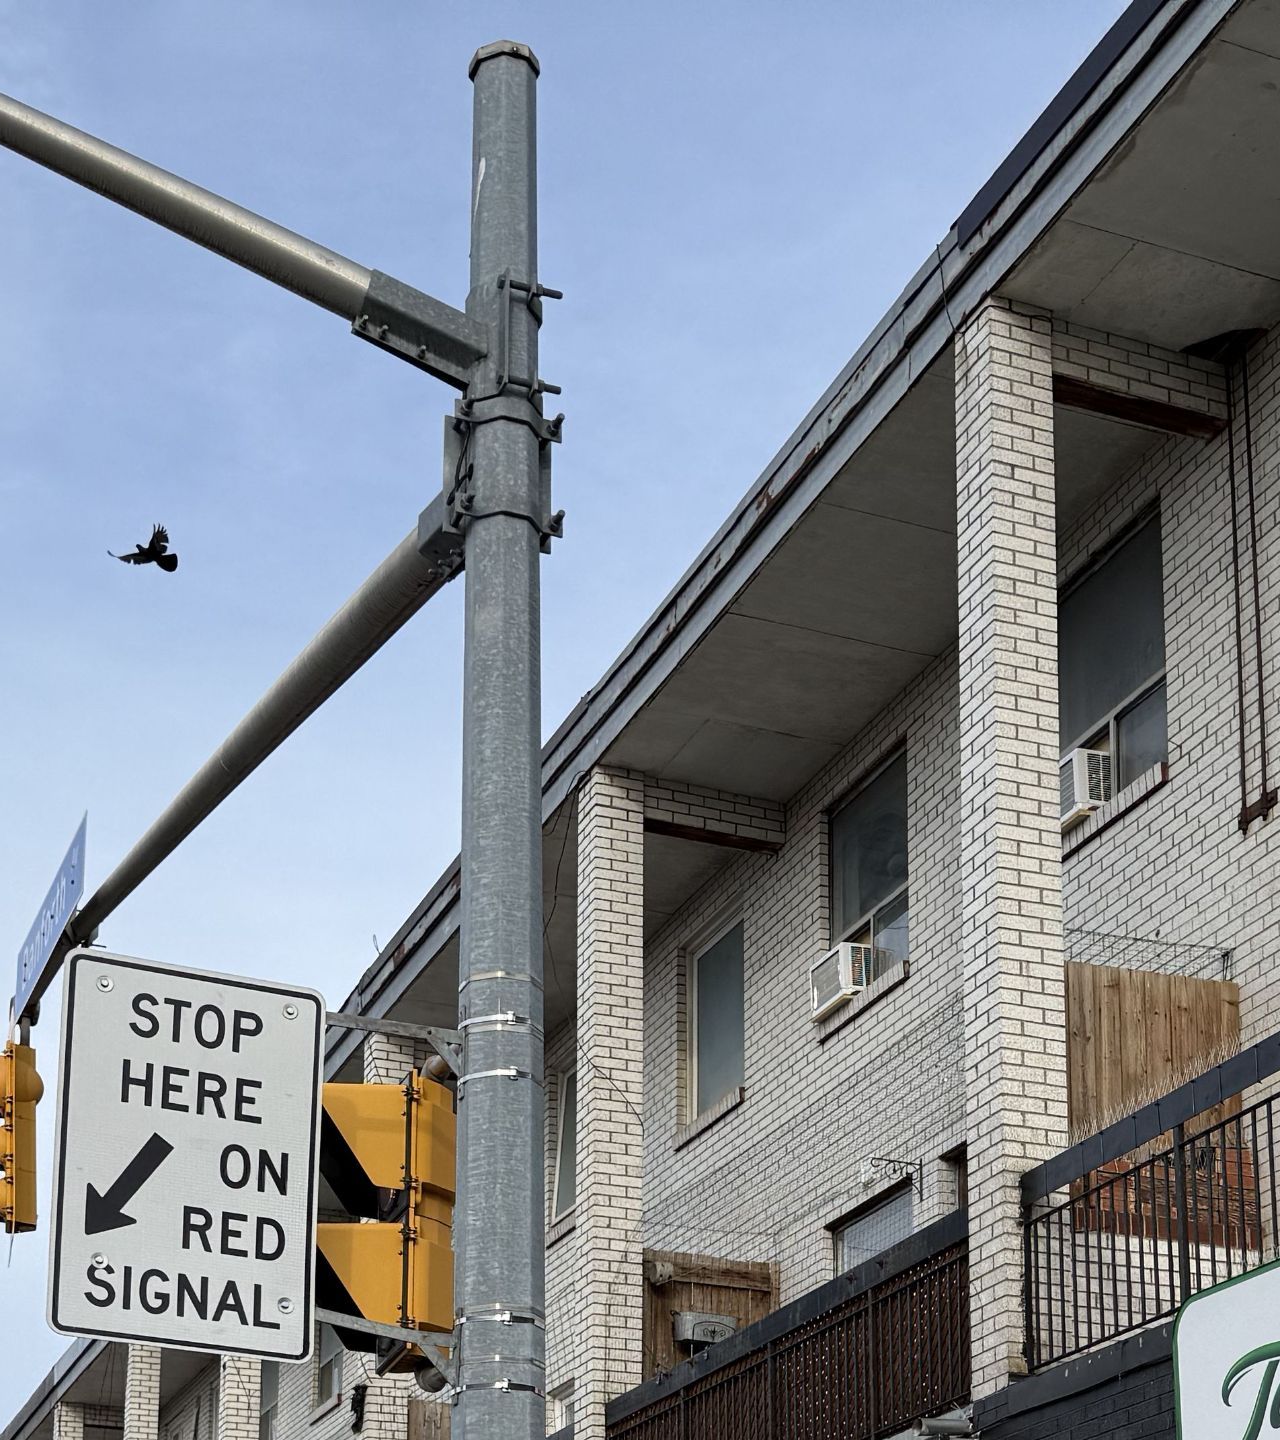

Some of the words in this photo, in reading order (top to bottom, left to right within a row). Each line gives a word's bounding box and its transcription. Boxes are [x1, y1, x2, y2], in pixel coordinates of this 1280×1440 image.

[129, 992, 263, 1053] STOP
[121, 1058, 263, 1125] HERE
[220, 1143, 289, 1196] ON
[182, 1206, 286, 1261] RED
[84, 1264, 281, 1330] SIGNAL
